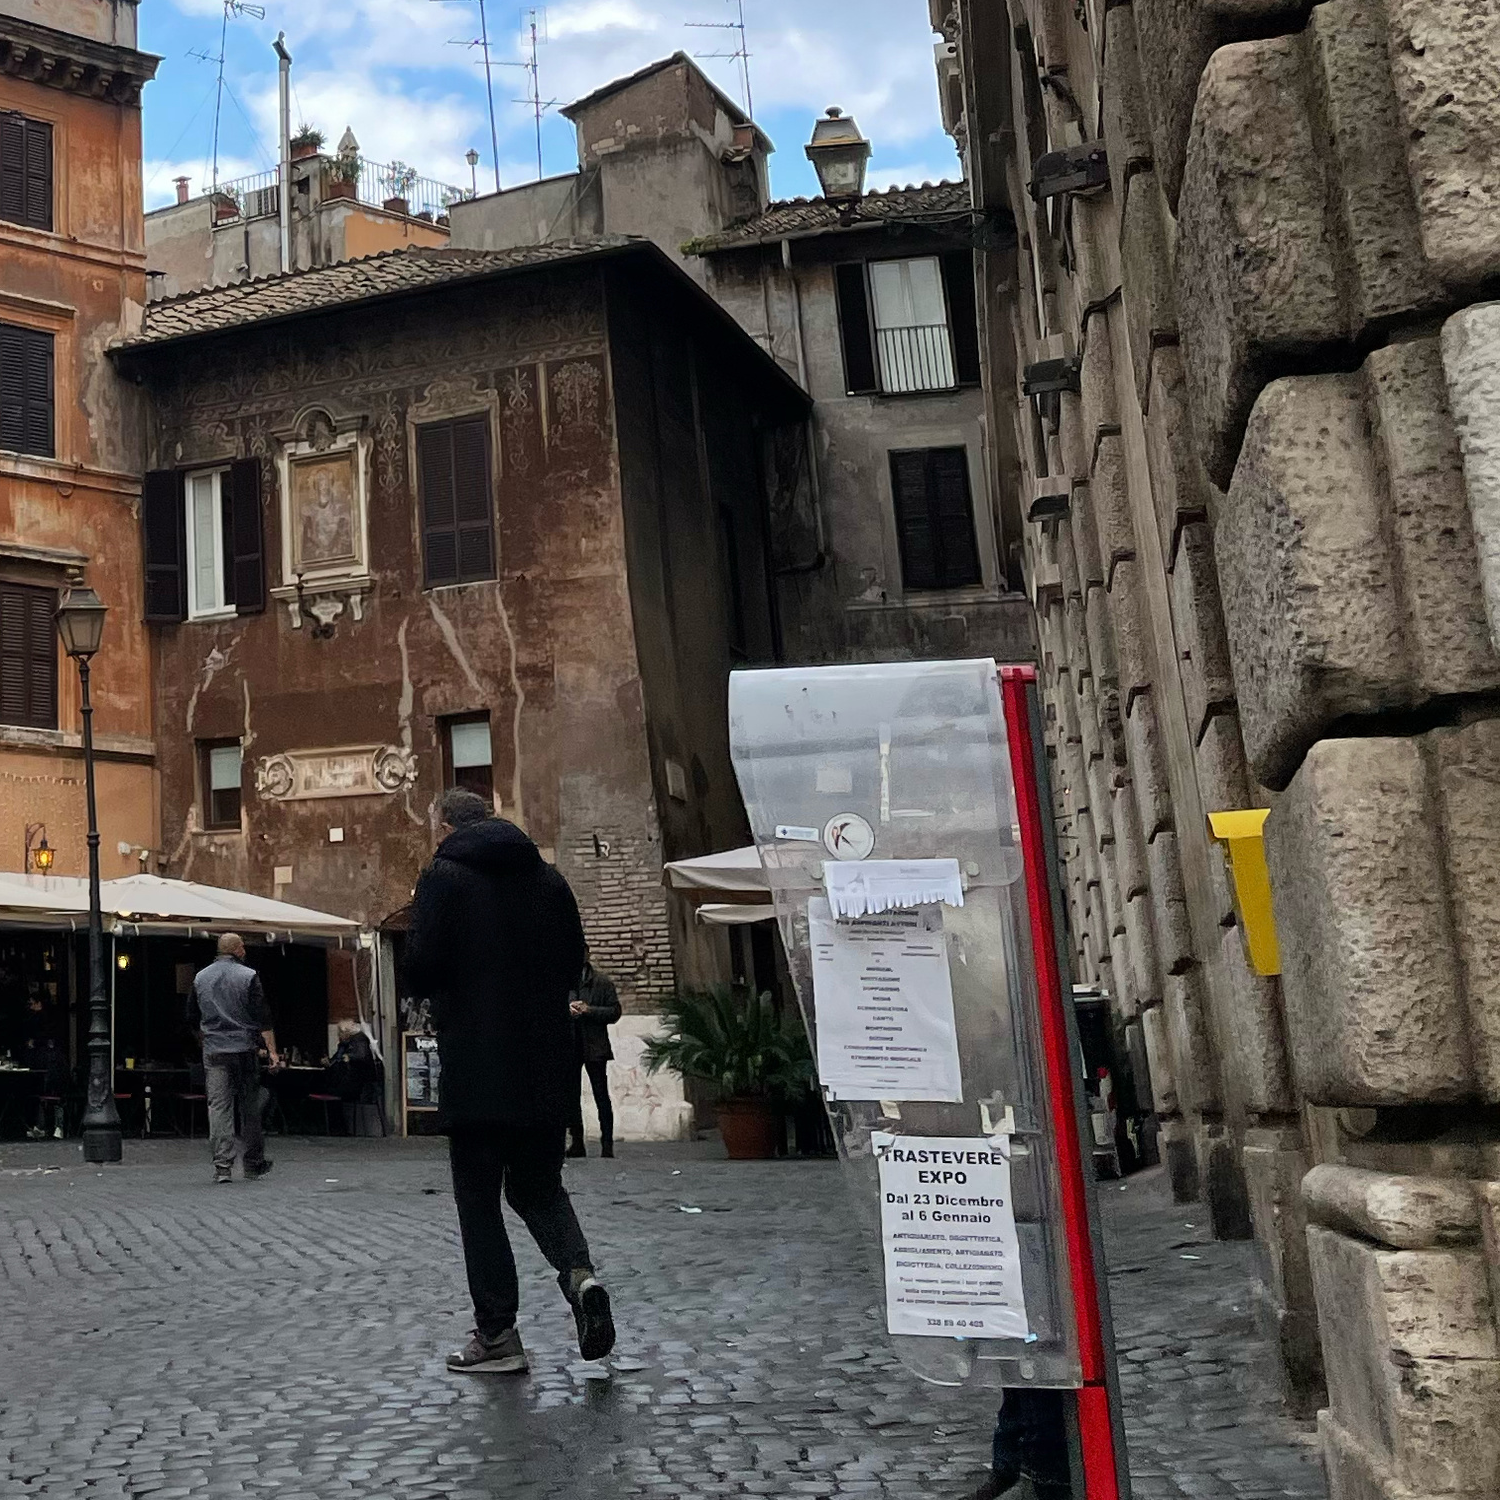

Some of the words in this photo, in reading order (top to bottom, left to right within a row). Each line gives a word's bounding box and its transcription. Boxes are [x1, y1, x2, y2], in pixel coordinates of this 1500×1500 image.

[878, 1145, 1002, 1166] TRASTEVERE
[918, 1170, 967, 1184] EXPO
[886, 1192, 908, 1204] Dal
[913, 1194, 930, 1205] 23
[935, 1194, 1004, 1207] Dicembre
[901, 1210, 914, 1221] al
[919, 1210, 927, 1221] 6
[932, 1210, 991, 1223] Gennaio
